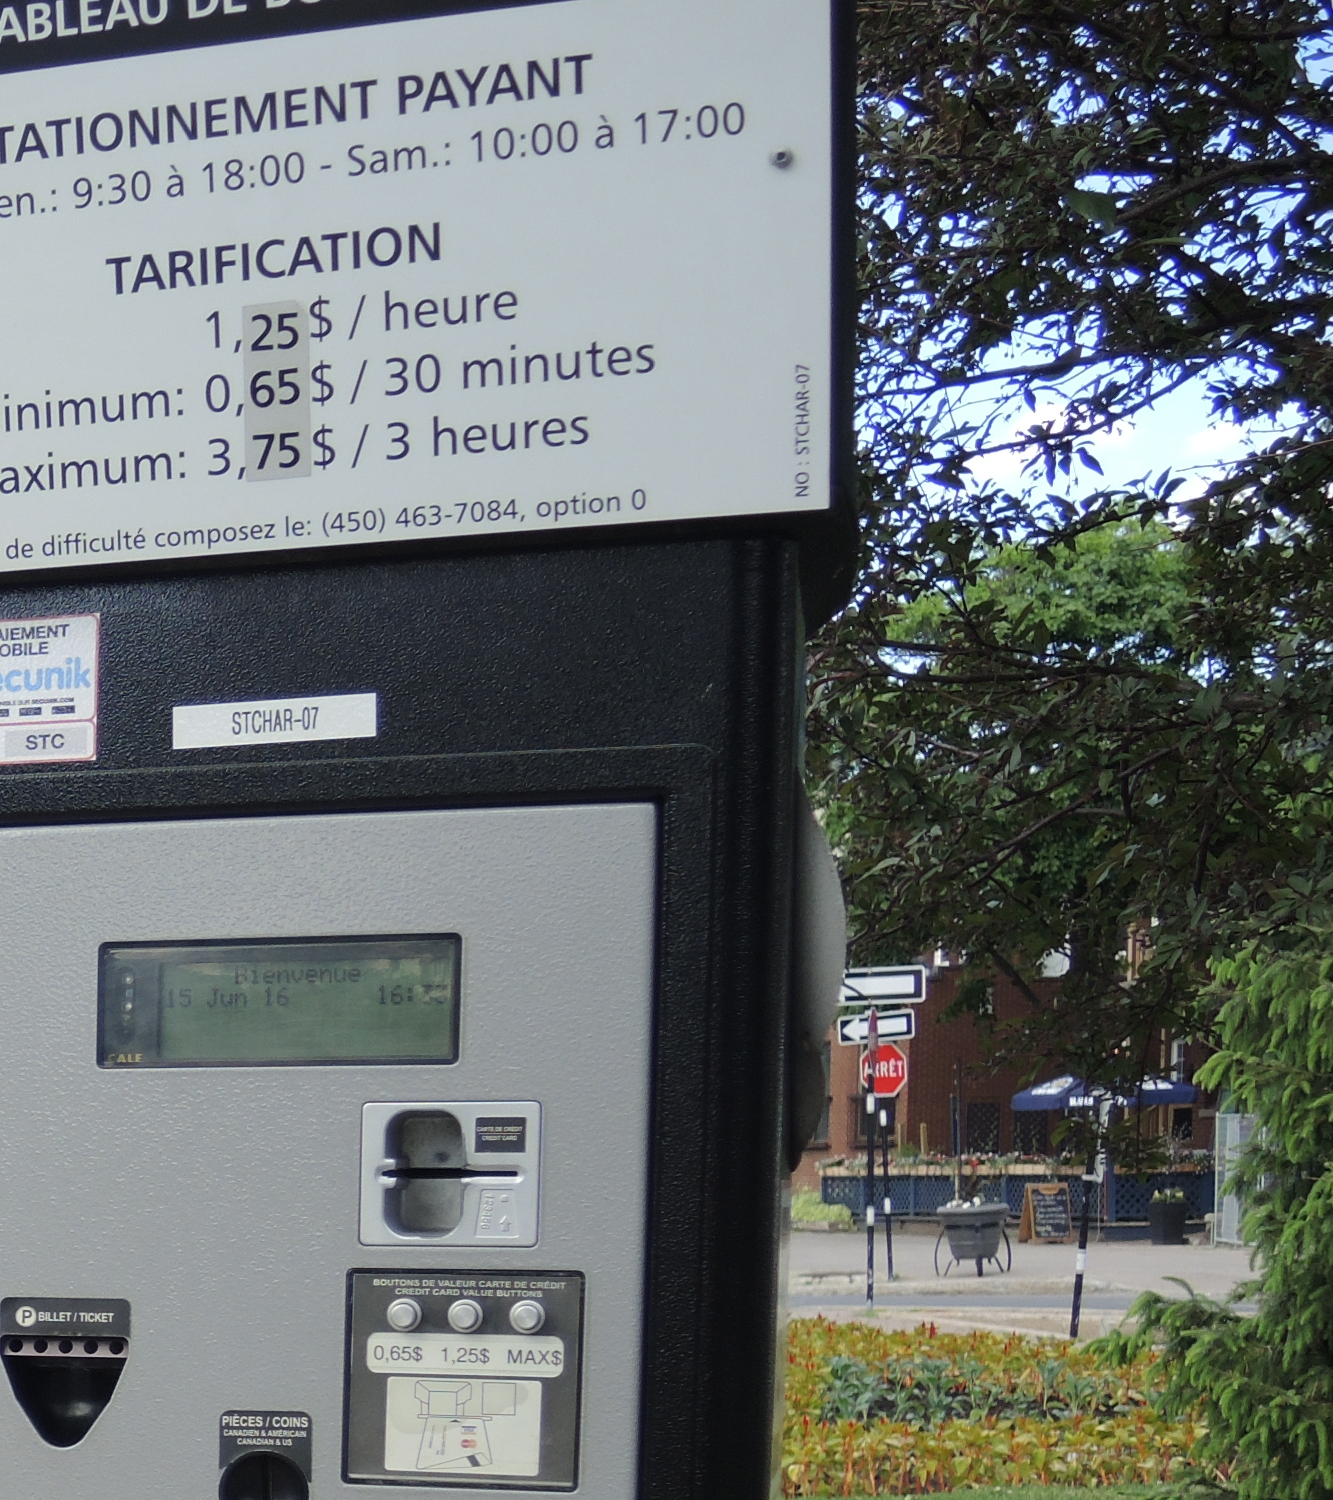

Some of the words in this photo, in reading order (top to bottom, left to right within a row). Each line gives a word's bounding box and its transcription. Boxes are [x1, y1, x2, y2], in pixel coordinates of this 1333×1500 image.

[396, 54, 593, 115] PAYANT
[72, 171, 151, 210] 9:30
[165, 165, 186, 198] à
[201, 151, 306, 193] 18:00
[347, 140, 450, 179] Sam.:
[469, 119, 579, 164] 10:00
[594, 116, 616, 150] à
[632, 102, 746, 146] 17:00
[106, 222, 442, 296] TARIFICATION
[205, 295, 333, 354] 1,25$
[348, 294, 367, 340] /
[383, 289, 519, 332] heure
[204, 360, 335, 417] 0,65$
[350, 359, 368, 405] /
[384, 354, 442, 396] 30
[461, 341, 657, 390] minutes
[795, 364, 811, 455] STCHAR-07
[207, 424, 336, 481] 3,75$
[350, 423, 370, 469] /
[385, 421, 411, 461] 3
[432, 413, 590, 457] heures
[795, 472, 810, 498] NO
[5, 538, 34, 560] de
[41, 527, 147, 557] difficulté
[154, 521, 276, 550] composez
[284, 515, 313, 537] le:
[321, 507, 387, 536] (450)
[395, 498, 527, 529] 463-7084,
[536, 491, 622, 521] option
[631, 488, 647, 511] 0
[230, 706, 321, 735] STCHAR-07
[25, 734, 65, 750] STC
[234, 966, 362, 985] Bienvenue
[166, 988, 193, 1008] 15
[206, 987, 248, 1008] Jun
[264, 986, 291, 1007] 16
[373, 1279, 420, 1287] BOUTONS
[422, 1279, 435, 1287] DE
[437, 1280, 476, 1288] VALEUR
[479, 1280, 512, 1289] CARTE
[514, 1281, 528, 1289] DE
[530, 1281, 567, 1290] CRÉDIT
[395, 1288, 430, 1296] CREDIT
[462, 1289, 494, 1297] VALUE
[496, 1289, 543, 1298] BUTTONS
[21, 1309, 33, 1324] P
[38, 1311, 73, 1322] BILLET
[79, 1312, 115, 1323] TICKET
[373, 1345, 423, 1363] 0,65$
[441, 1347, 490, 1365] 1,25$
[507, 1349, 563, 1367] MAX$
[223, 1429, 260, 1437] CANADIEN
[272, 1416, 309, 1428] COINS
[237, 1438, 274, 1446] CANADIAN
